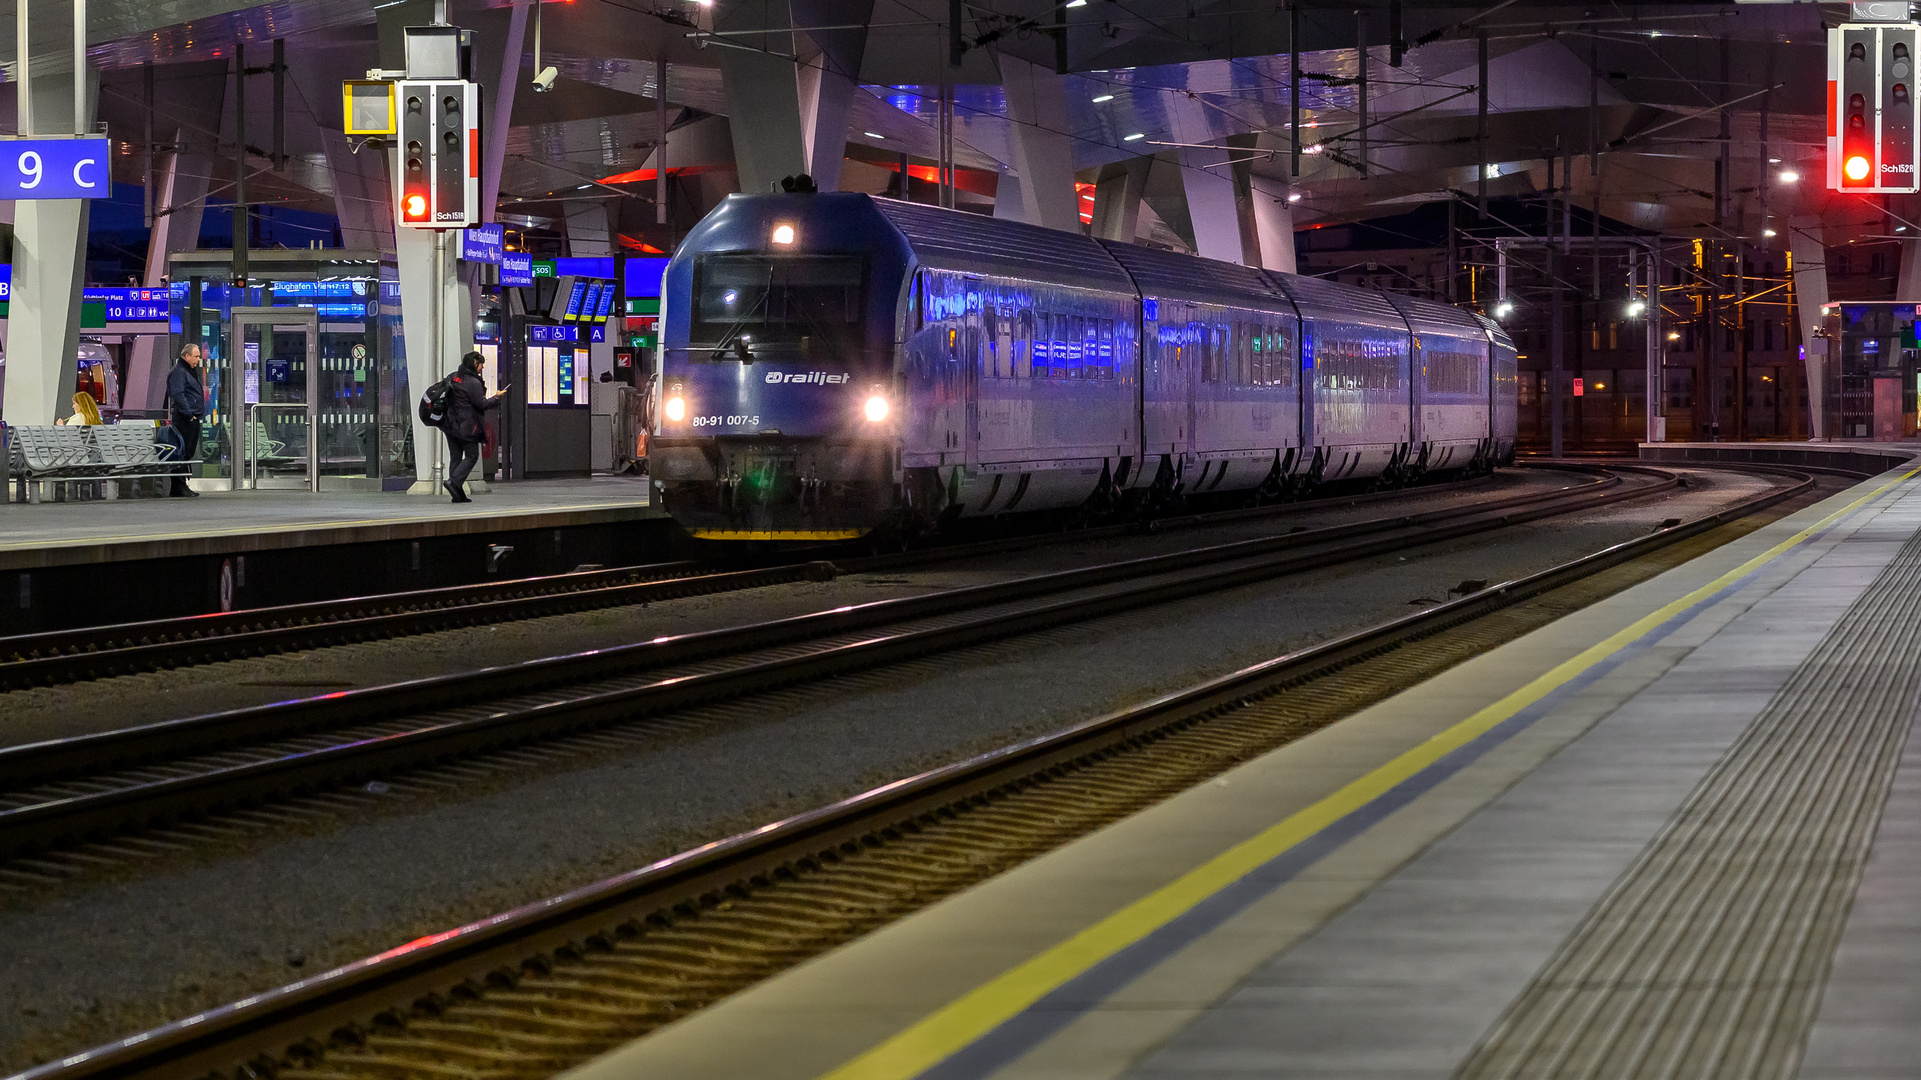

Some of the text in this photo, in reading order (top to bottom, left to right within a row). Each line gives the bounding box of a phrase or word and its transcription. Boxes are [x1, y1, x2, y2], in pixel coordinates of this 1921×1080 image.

[18, 151, 43, 189] 9
[1881, 164, 1914, 173] Sch152R
[0, 283, 9, 296] B
[109, 308, 122, 317] 10
[573, 327, 579, 340] 1
[592, 330, 602, 340] A
[272, 368, 277, 376] P
[783, 372, 850, 386] railjet
[692, 415, 760, 427] 80-91 007-5
